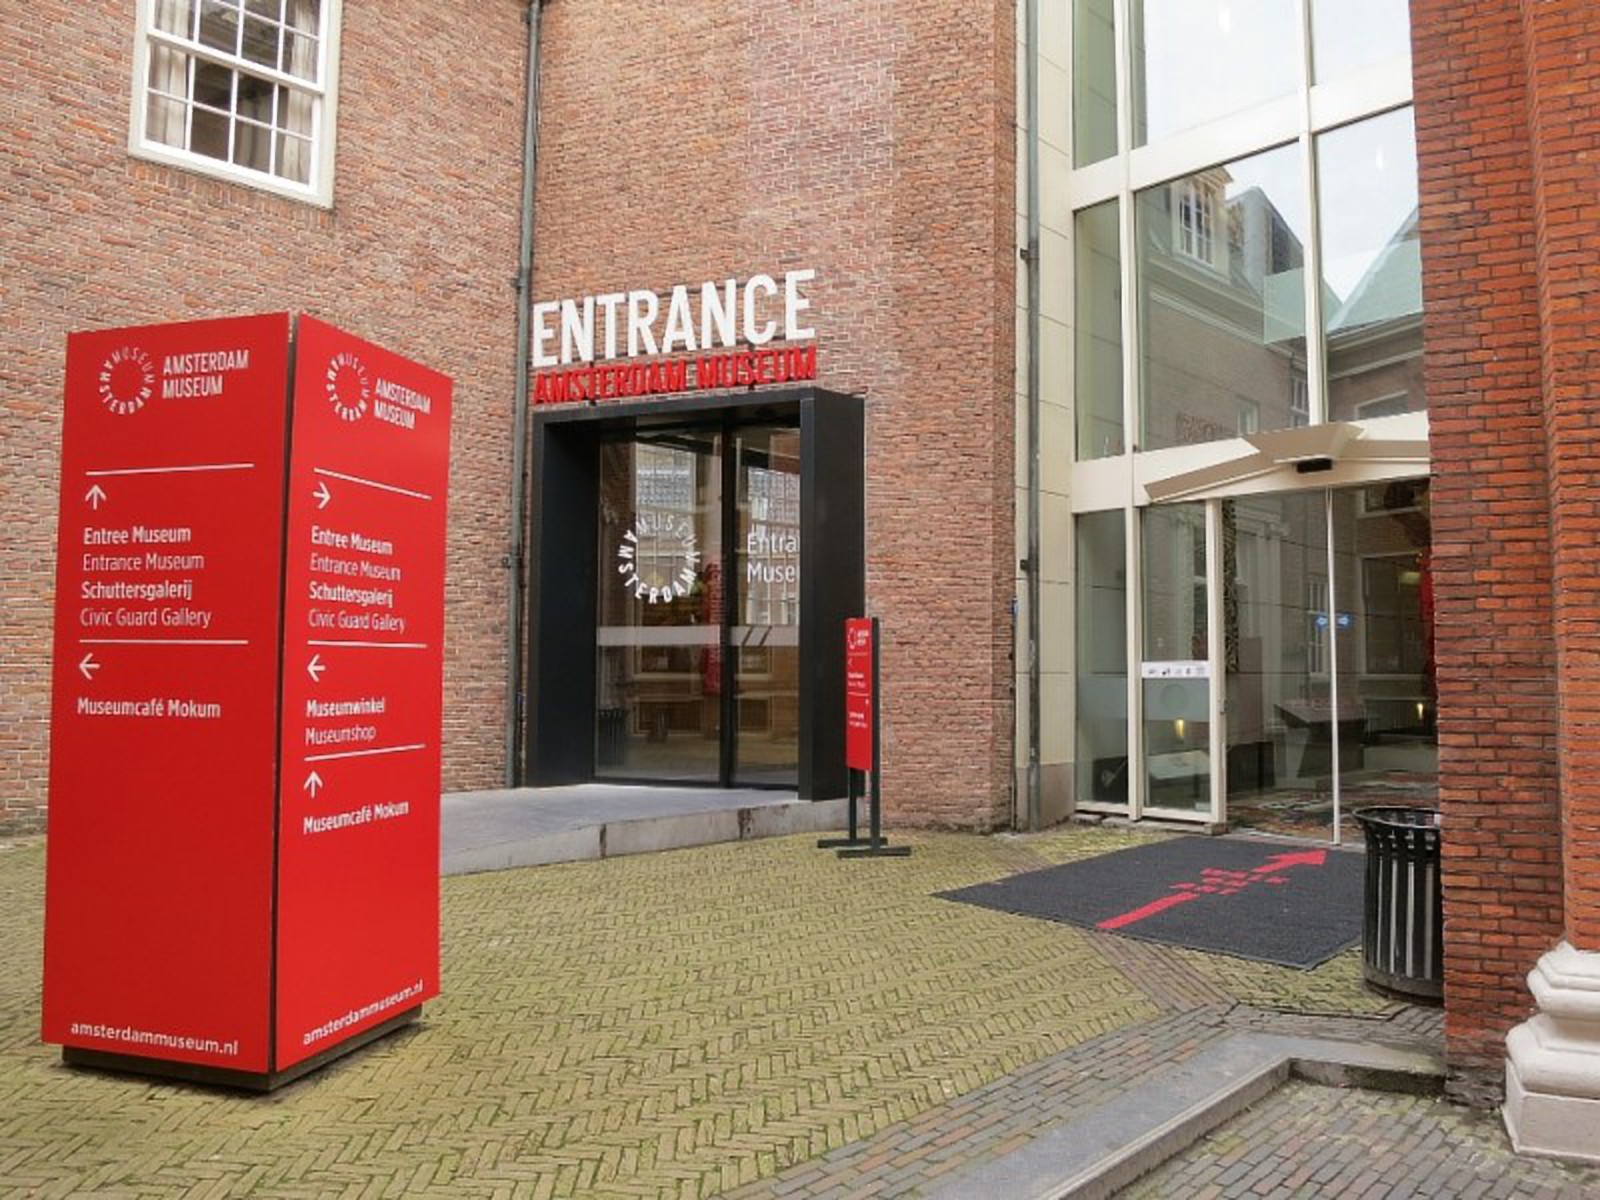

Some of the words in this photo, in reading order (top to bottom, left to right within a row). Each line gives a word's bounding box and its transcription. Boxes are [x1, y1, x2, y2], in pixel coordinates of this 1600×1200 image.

[532, 268, 816, 368] ENTRANCE
[163, 349, 250, 376] AMSTERDAM
[534, 358, 688, 405] AMSTERDAM
[696, 345, 817, 391] MUSEUM
[162, 375, 223, 399] MUSEUM
[375, 377, 432, 416] AMSTERDAM
[374, 399, 415, 430] MUSEUM
[83, 526, 129, 545] Entree
[132, 524, 192, 544] Museum
[311, 525, 348, 549] Entree
[351, 532, 393, 555] Museum
[747, 532, 800, 554] Entra
[83, 552, 142, 571] Entrance
[145, 551, 205, 570] Museum
[310, 552, 358, 576] Entrance
[360, 560, 401, 582] Museum
[747, 561, 800, 584] Muse
[81, 579, 193, 602] Schuttersgalerij
[309, 580, 393, 608] Schuttersgalerij
[80, 607, 112, 627] Civic
[116, 607, 158, 627] Guard
[161, 607, 212, 629] Gallery
[308, 608, 335, 628] Civic
[337, 610, 370, 630] Guard
[372, 612, 405, 635] Gallery
[77, 697, 164, 718] Museumcafé
[167, 699, 221, 718] Mokum
[306, 697, 385, 718] Museumwinkel
[305, 724, 376, 745] Museumshop
[303, 807, 373, 834] Museumcafé
[374, 800, 409, 820] Mokum
[303, 979, 424, 1046] amsterdammuseum.nl
[70, 1021, 239, 1056] amsterdammuseum.nl
